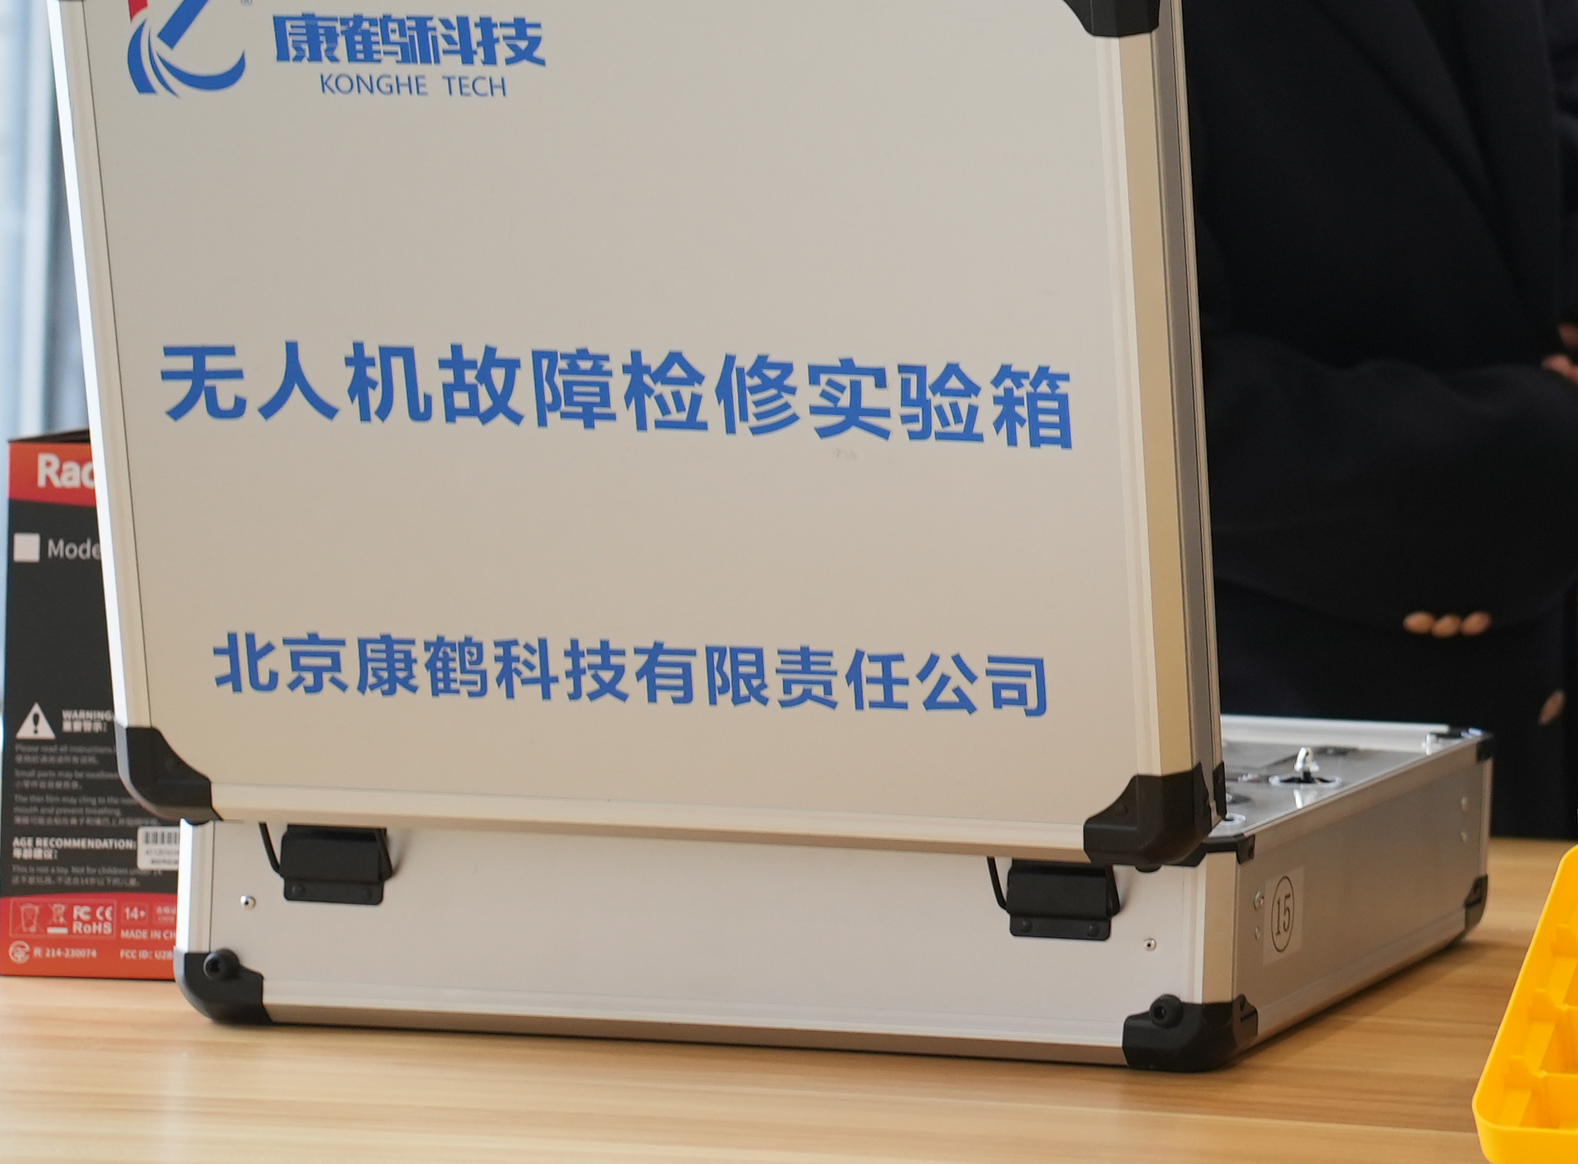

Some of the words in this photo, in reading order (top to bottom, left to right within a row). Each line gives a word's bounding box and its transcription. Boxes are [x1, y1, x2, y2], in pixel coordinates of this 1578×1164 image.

[273, 11, 546, 68] 康鹤科技
[320, 72, 428, 97] KONGHE
[442, 75, 507, 99] TECH
[160, 340, 1075, 450] 无人机故障检修实验箱
[213, 631, 1049, 718] 北京康鹤科技有限责任公司
[13, 837, 34, 848] AGE
[73, 921, 113, 934] RoHS
[1275, 893, 1291, 936] 15
[121, 929, 148, 939] MADE
[150, 929, 162, 940] IN
[120, 949, 137, 959] FCC
